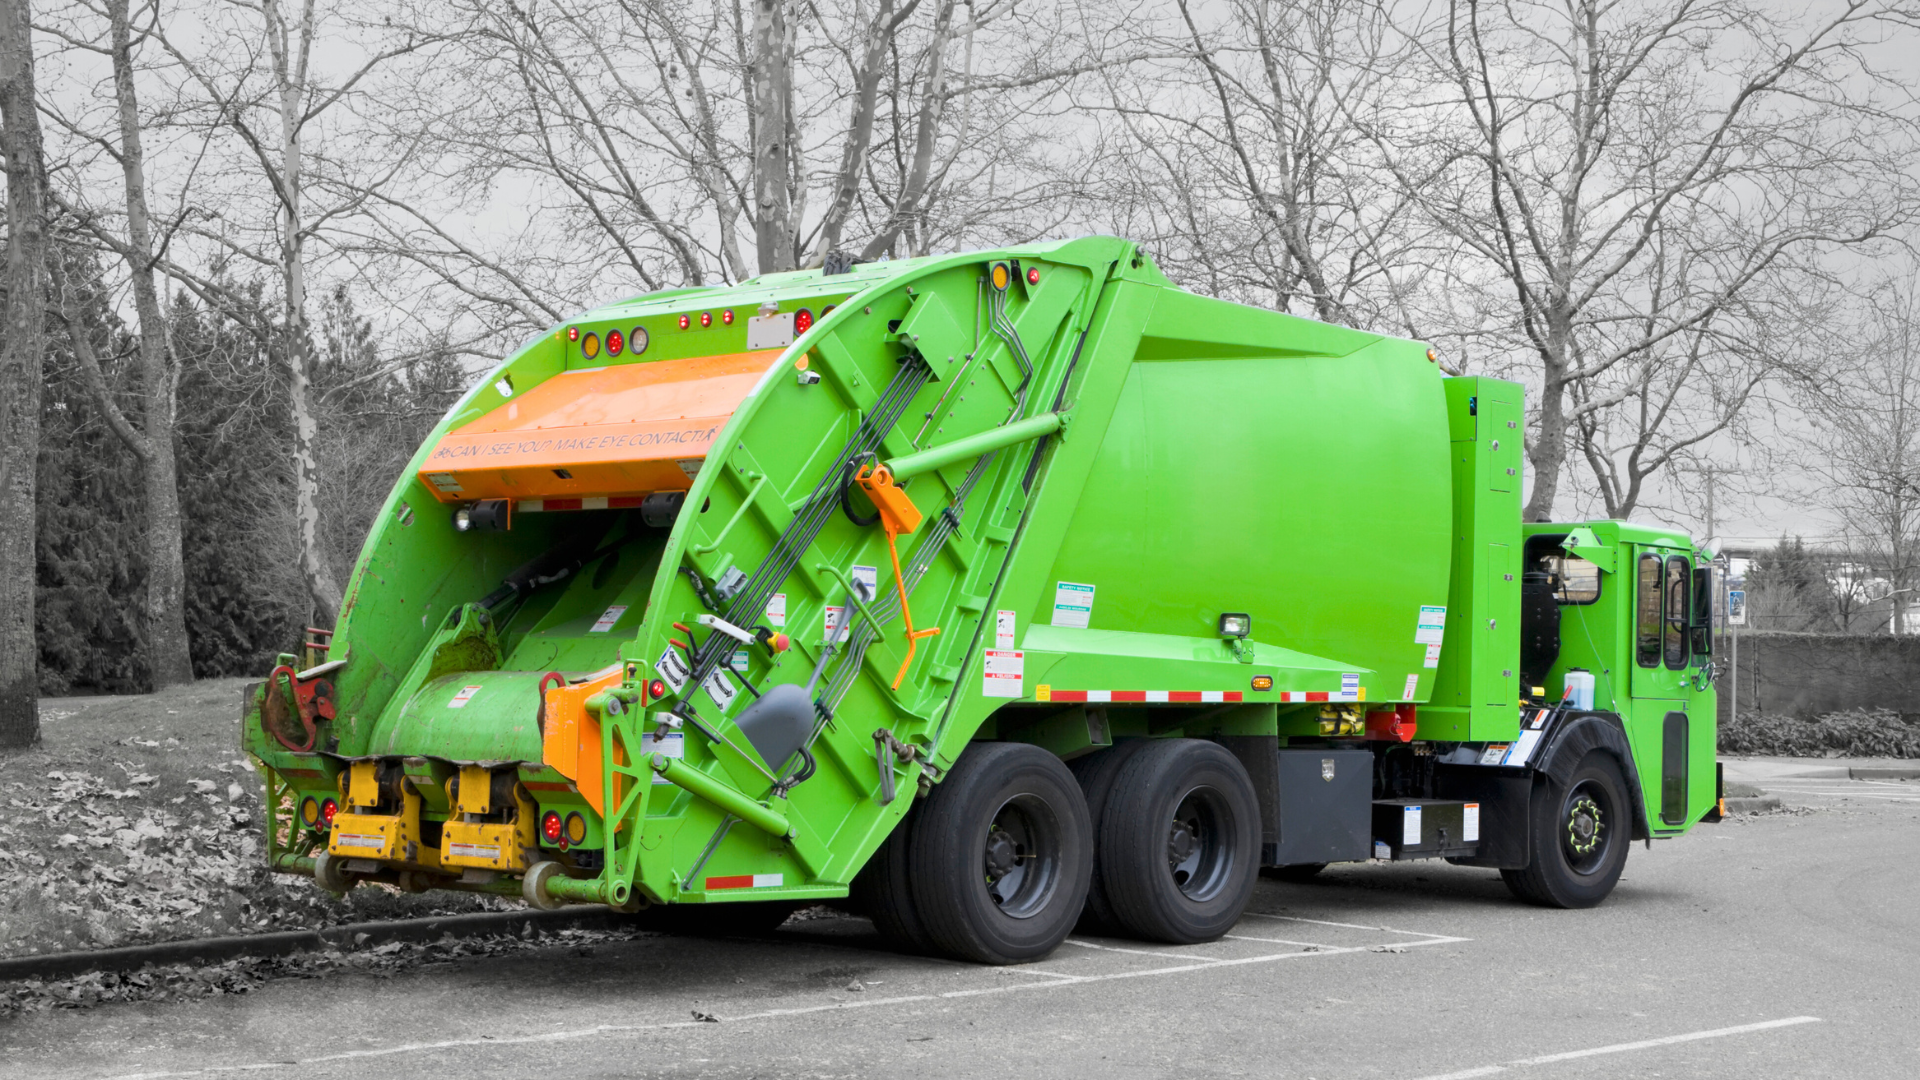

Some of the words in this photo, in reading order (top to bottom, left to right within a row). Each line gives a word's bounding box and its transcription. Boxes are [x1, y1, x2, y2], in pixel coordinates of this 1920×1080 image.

[450, 445, 480, 458] CAN
[487, 442, 515, 456] SEE
[515, 440, 552, 453] YOU?
[553, 437, 598, 451] MAKE
[598, 435, 629, 448] EYE
[629, 430, 705, 447] CONTACT!
